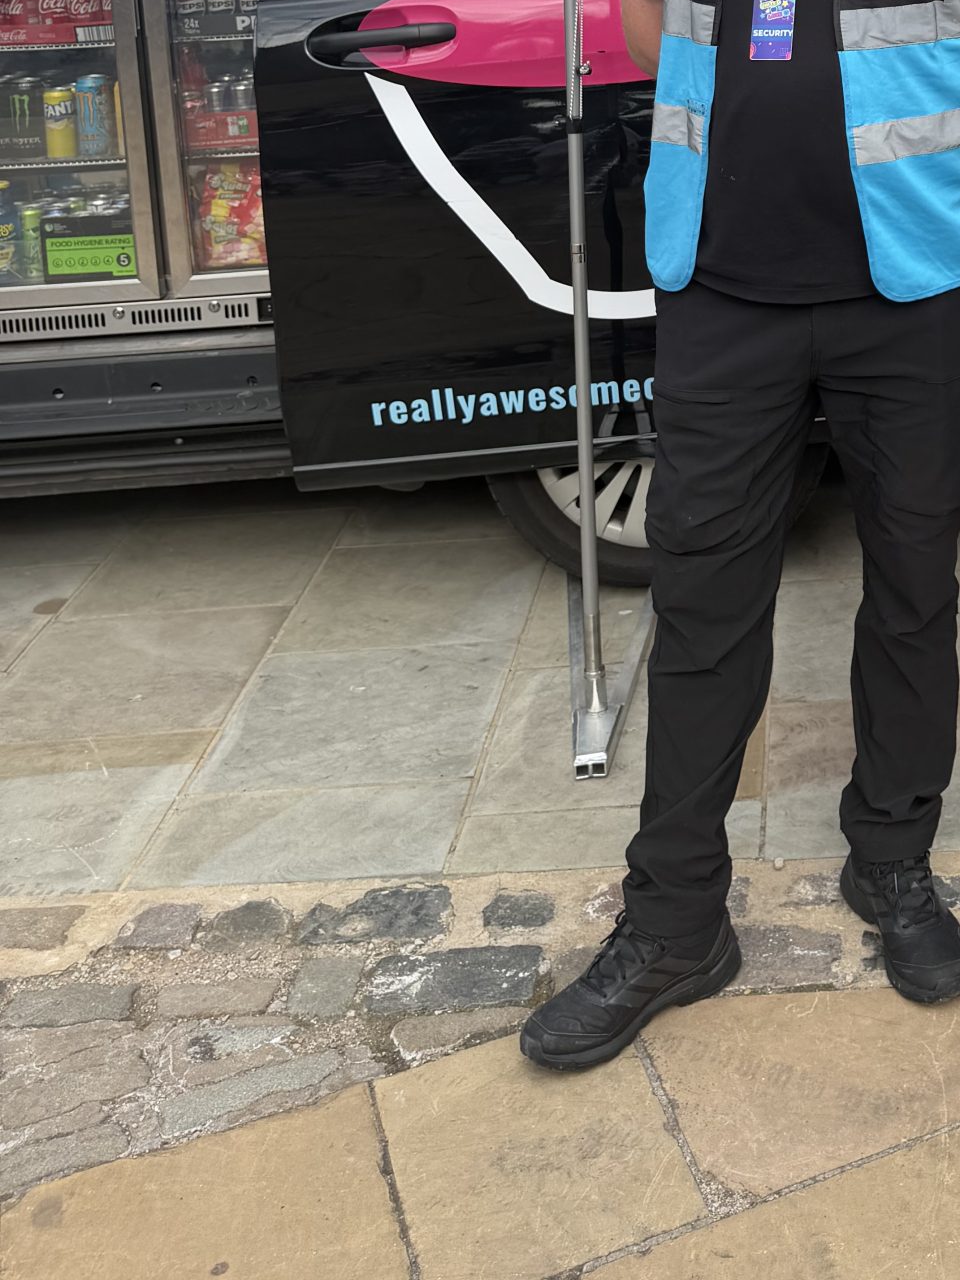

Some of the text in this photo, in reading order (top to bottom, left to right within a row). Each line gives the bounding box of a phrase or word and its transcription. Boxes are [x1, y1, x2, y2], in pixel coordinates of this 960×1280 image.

[208, 0, 234, 9] PEPSI
[752, 29, 793, 37] SECURITY
[44, 100, 73, 118] FANT
[74, 239, 103, 247] HYGIENE
[104, 237, 131, 245] RATING
